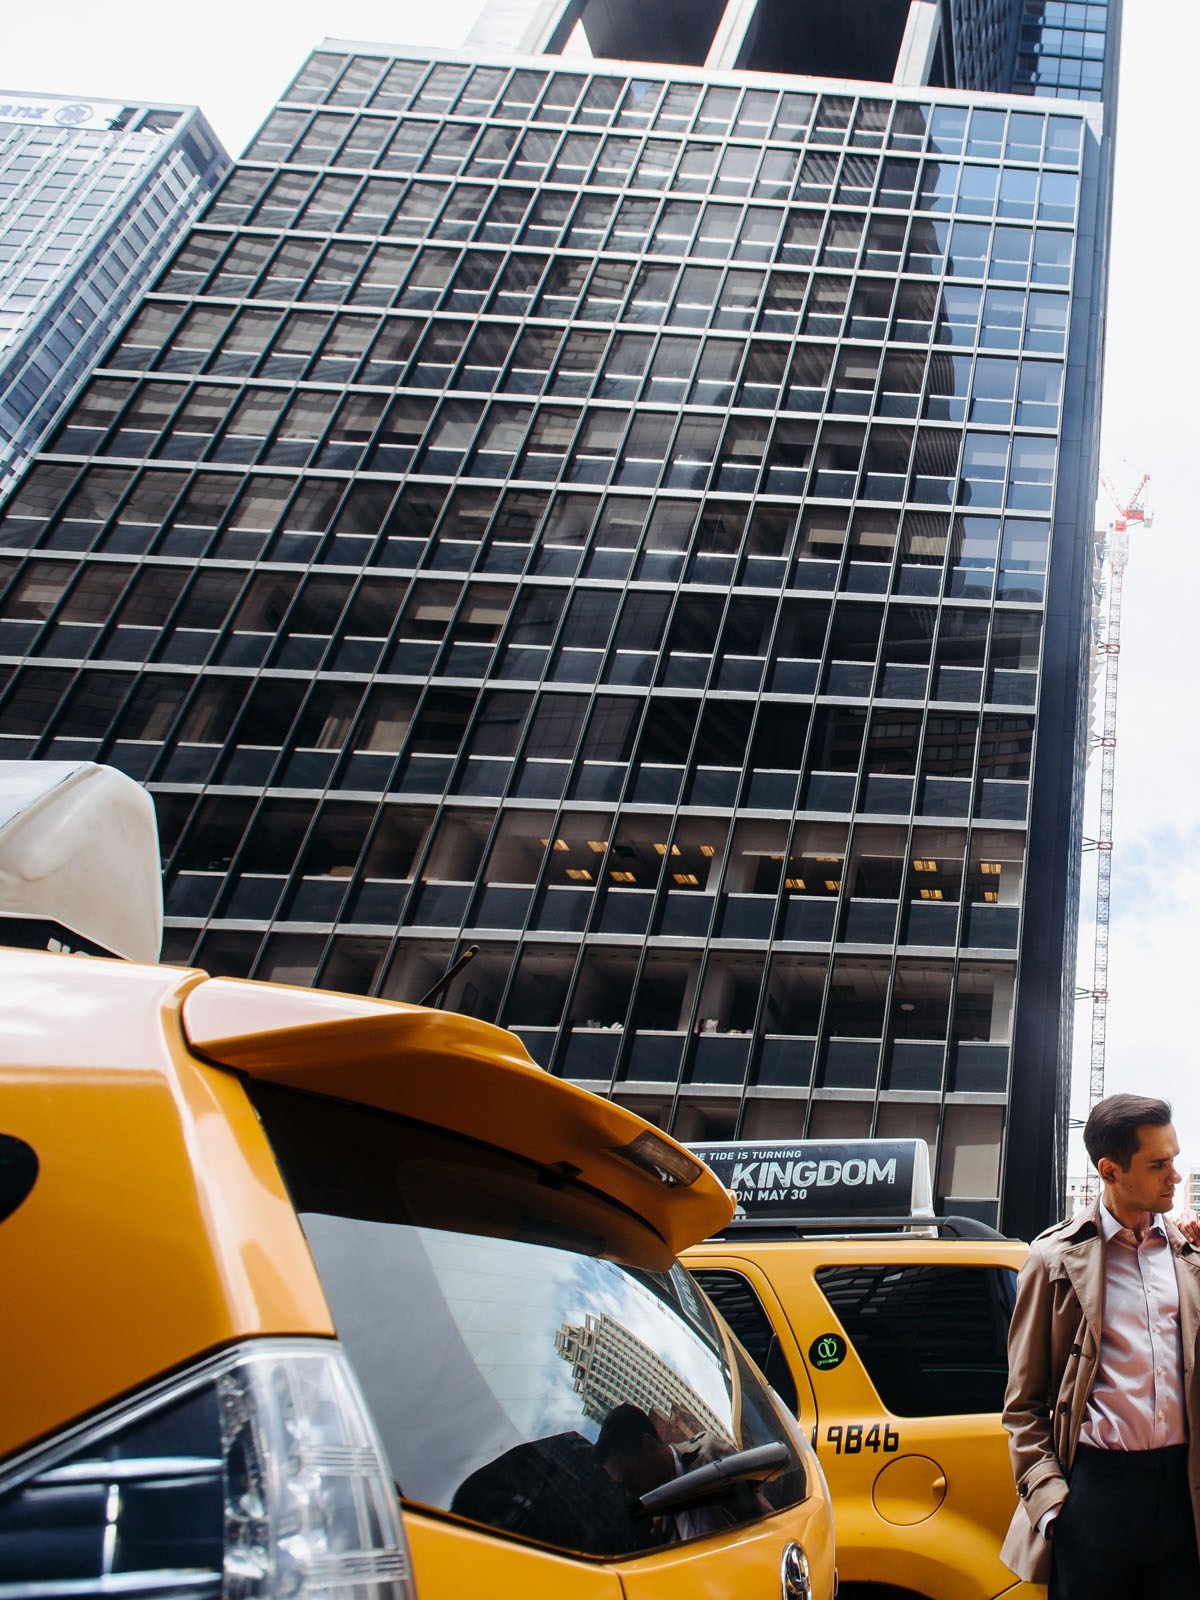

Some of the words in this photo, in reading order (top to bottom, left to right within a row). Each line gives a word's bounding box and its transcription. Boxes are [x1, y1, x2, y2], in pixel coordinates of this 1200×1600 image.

[709, 1152, 734, 1161] TIDE
[737, 1150, 749, 1160] IS
[752, 1150, 802, 1159] TURNING
[730, 1158, 897, 1190] KINGDOM
[735, 1190, 754, 1202] ON
[757, 1190, 787, 1201] MAY
[790, 1189, 808, 1200] 30
